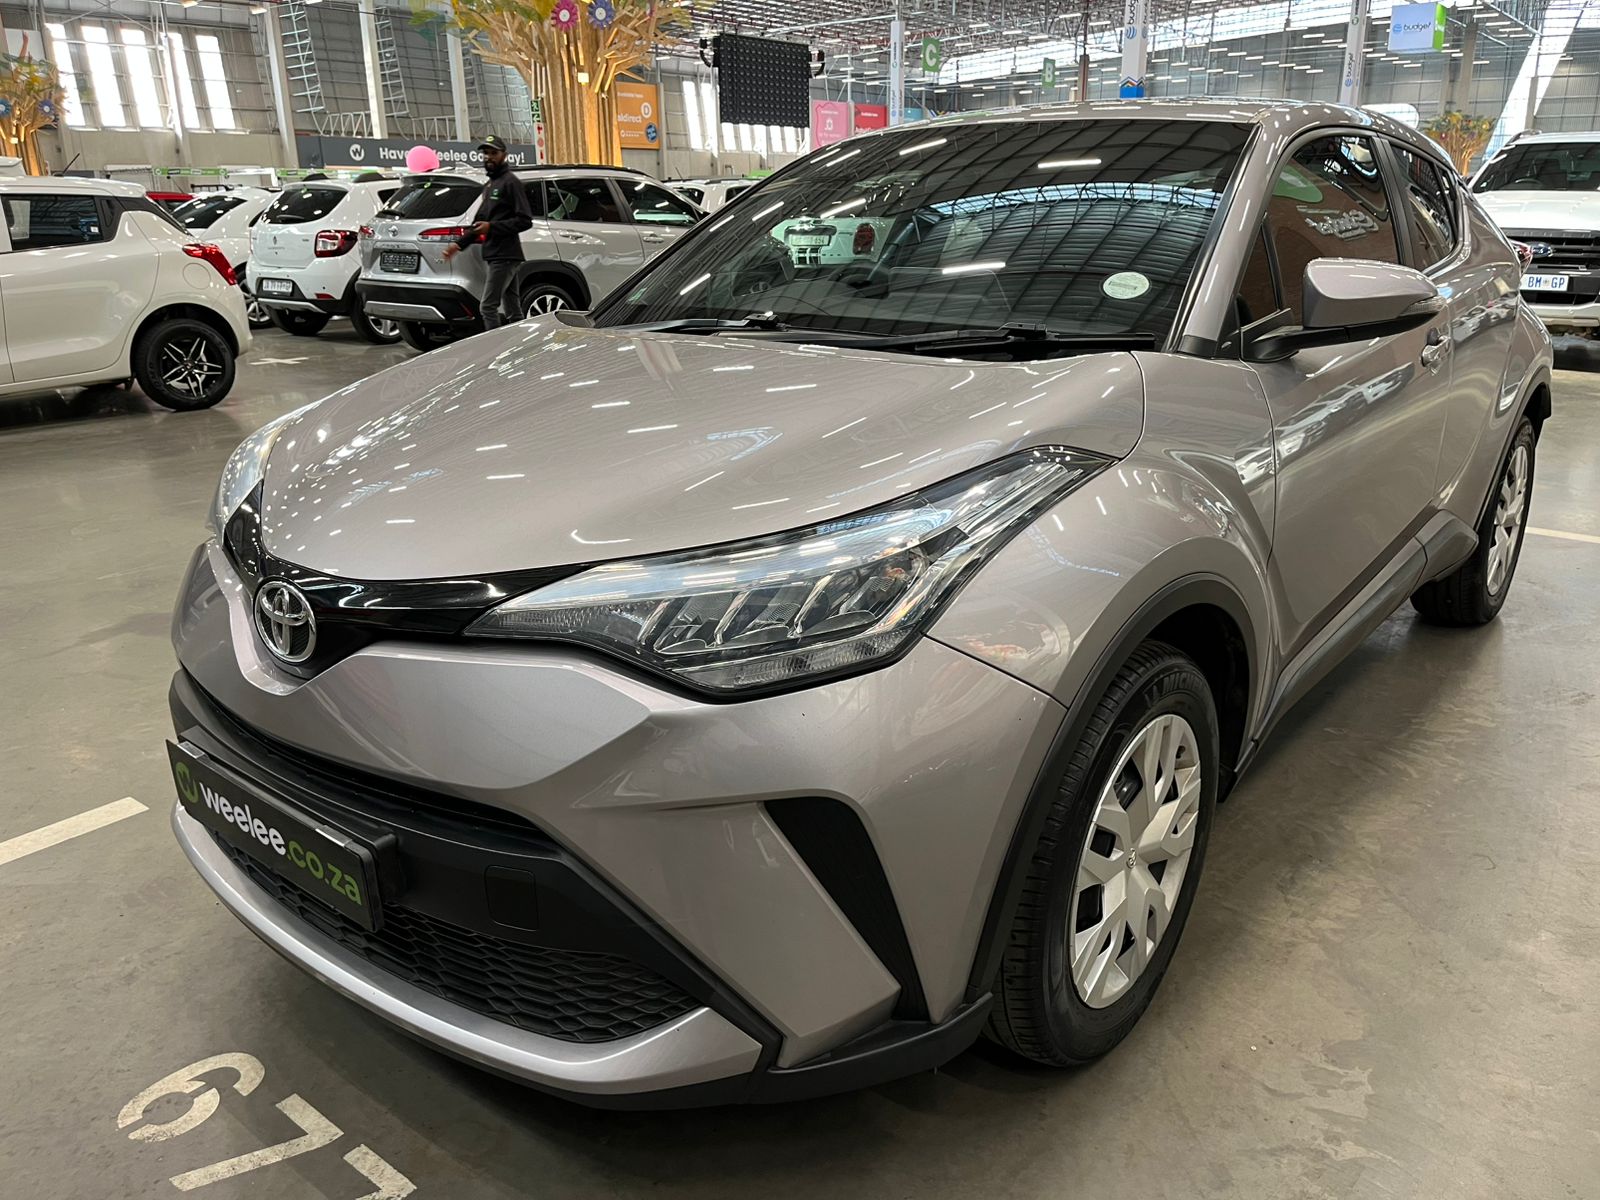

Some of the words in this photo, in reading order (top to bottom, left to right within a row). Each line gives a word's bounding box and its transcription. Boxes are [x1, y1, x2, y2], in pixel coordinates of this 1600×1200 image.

[1126, 0, 1139, 25] budg
[1403, 22, 1432, 32] budget
[925, 43, 937, 67] C
[1346, 52, 1356, 78] budget
[1045, 63, 1053, 83] B
[504, 152, 525, 165] ay!
[1528, 276, 1542, 288] BM
[1551, 277, 1565, 289] GP
[199, 782, 363, 905] weelee.co.za
